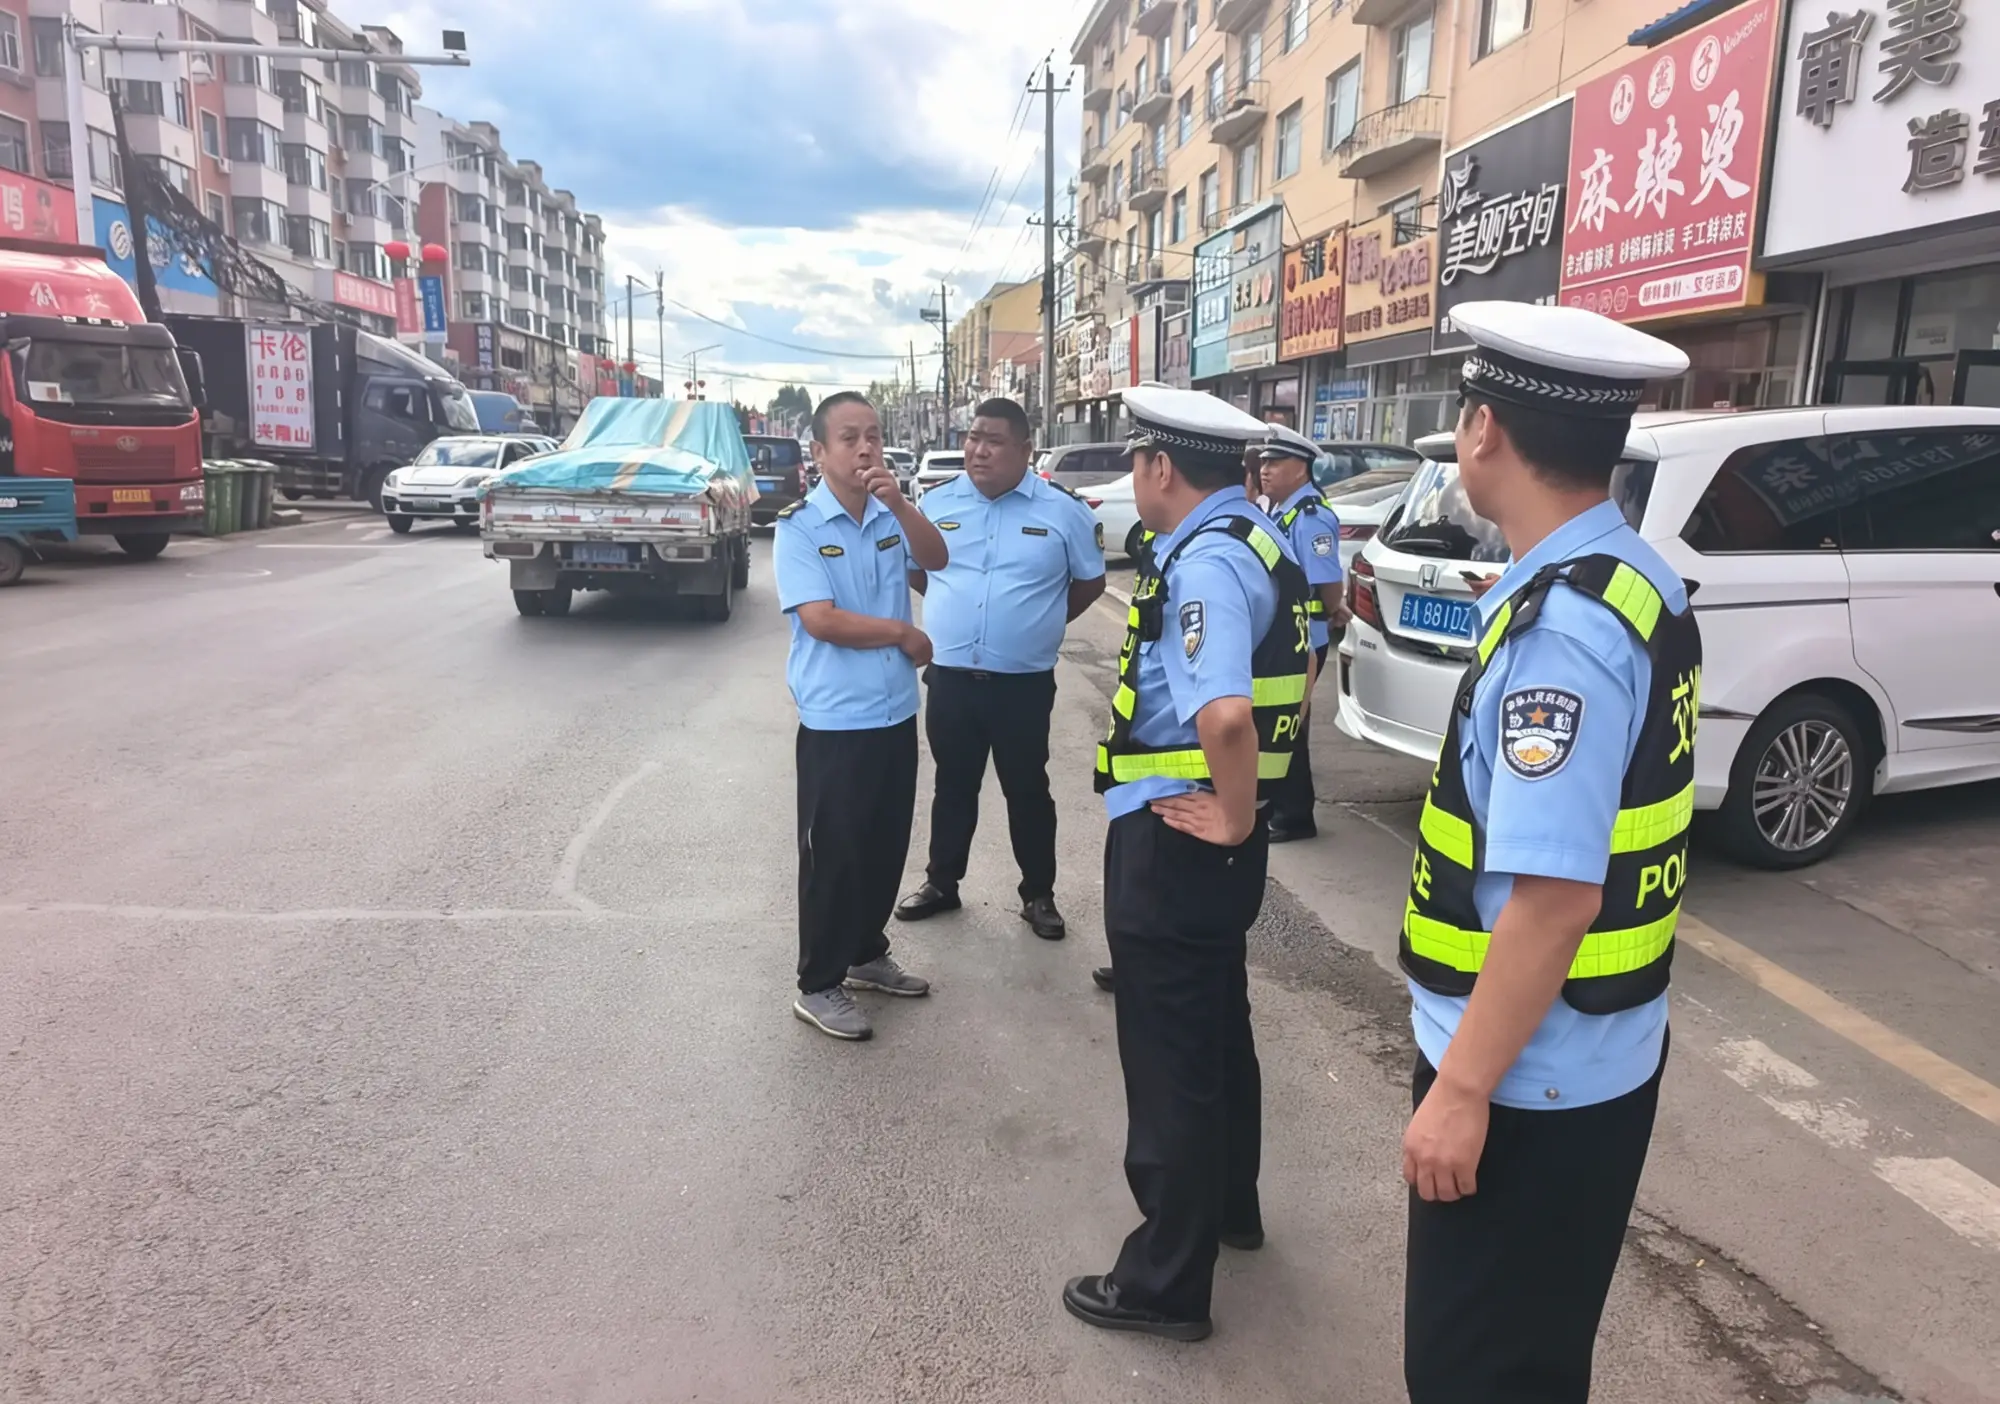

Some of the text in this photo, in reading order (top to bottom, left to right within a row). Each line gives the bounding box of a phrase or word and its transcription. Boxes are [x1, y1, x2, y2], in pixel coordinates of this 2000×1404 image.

[1796, 0, 1966, 132] 审美
[1568, 89, 1751, 234] 麻辣烫
[1442, 183, 1560, 284] 美丽空间
[250, 328, 306, 361] 卡伦
